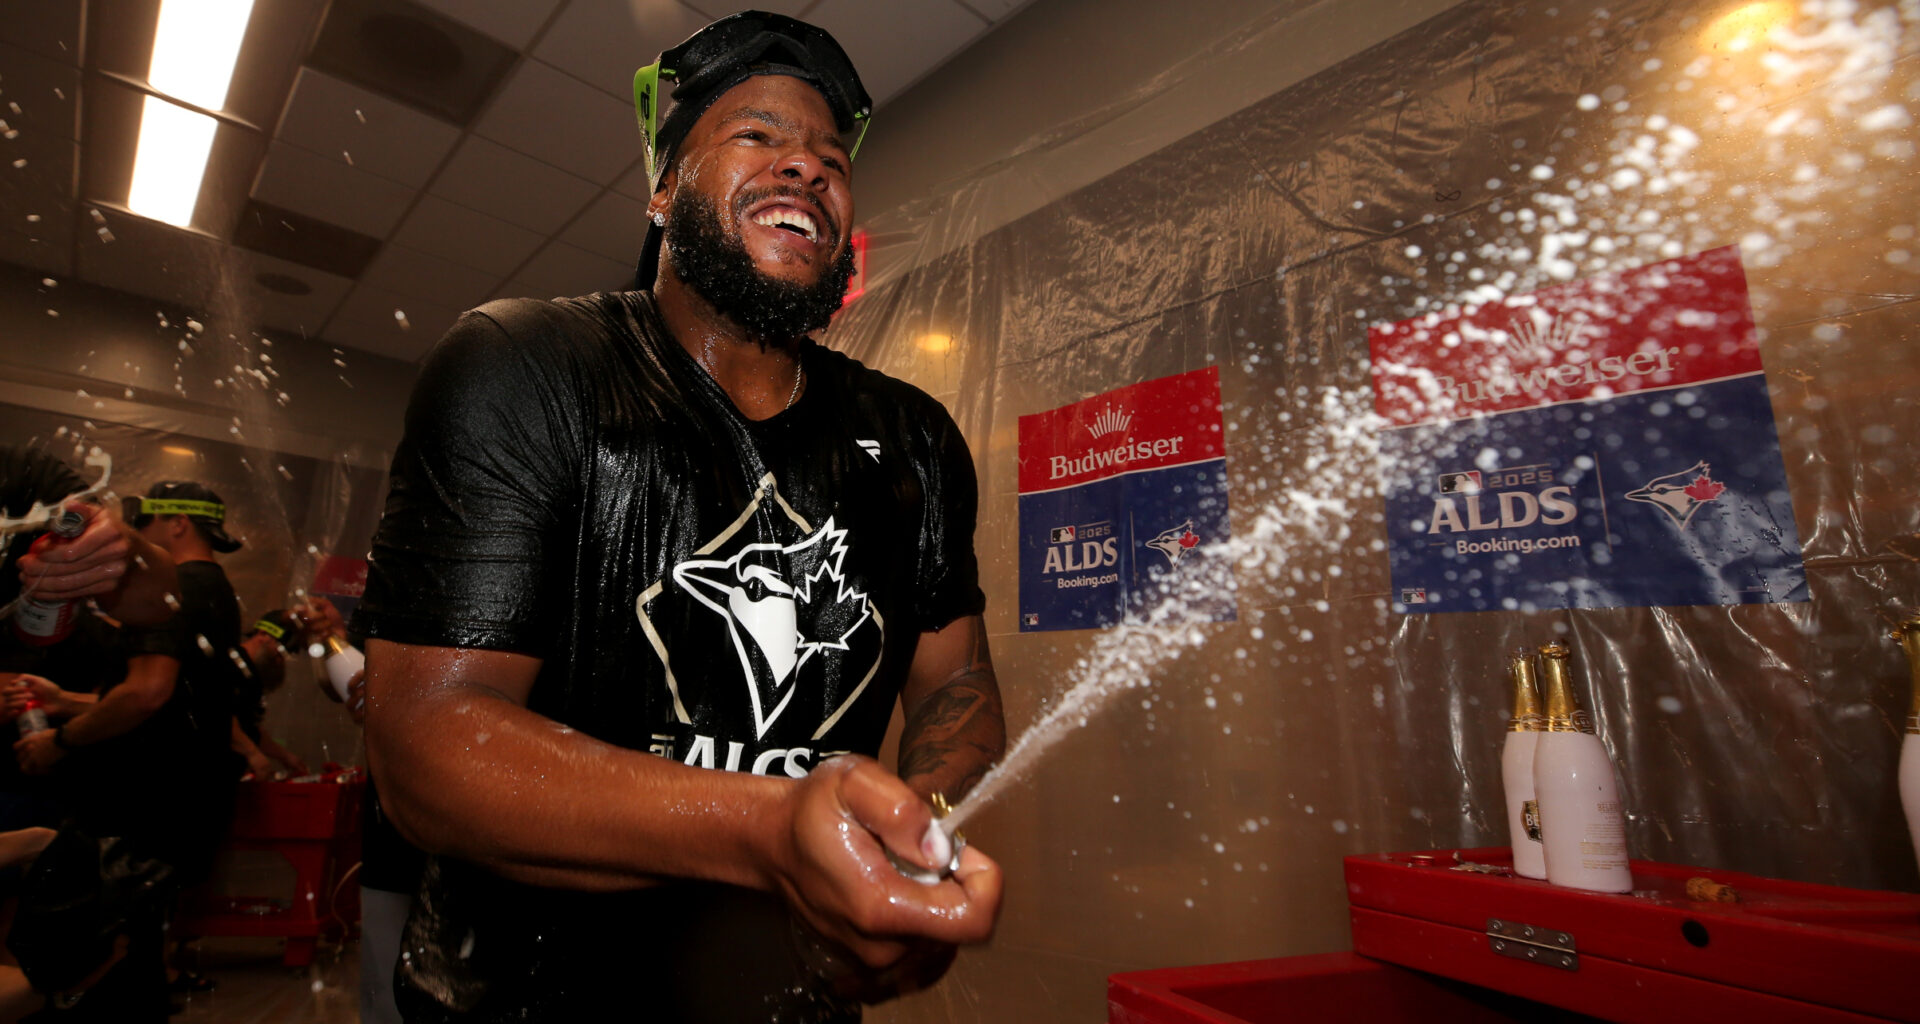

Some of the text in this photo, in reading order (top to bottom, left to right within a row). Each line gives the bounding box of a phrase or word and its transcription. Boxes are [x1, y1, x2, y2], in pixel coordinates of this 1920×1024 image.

[1050, 436, 1183, 479] Budweiser
[1490, 471, 1553, 487] 2025
[1428, 486, 1578, 534] ALDS
[1079, 526, 1110, 539] 2025
[1457, 534, 1580, 554] Booking.com
[1043, 538, 1117, 573] ALDS
[1058, 573, 1118, 589] Booking.com
